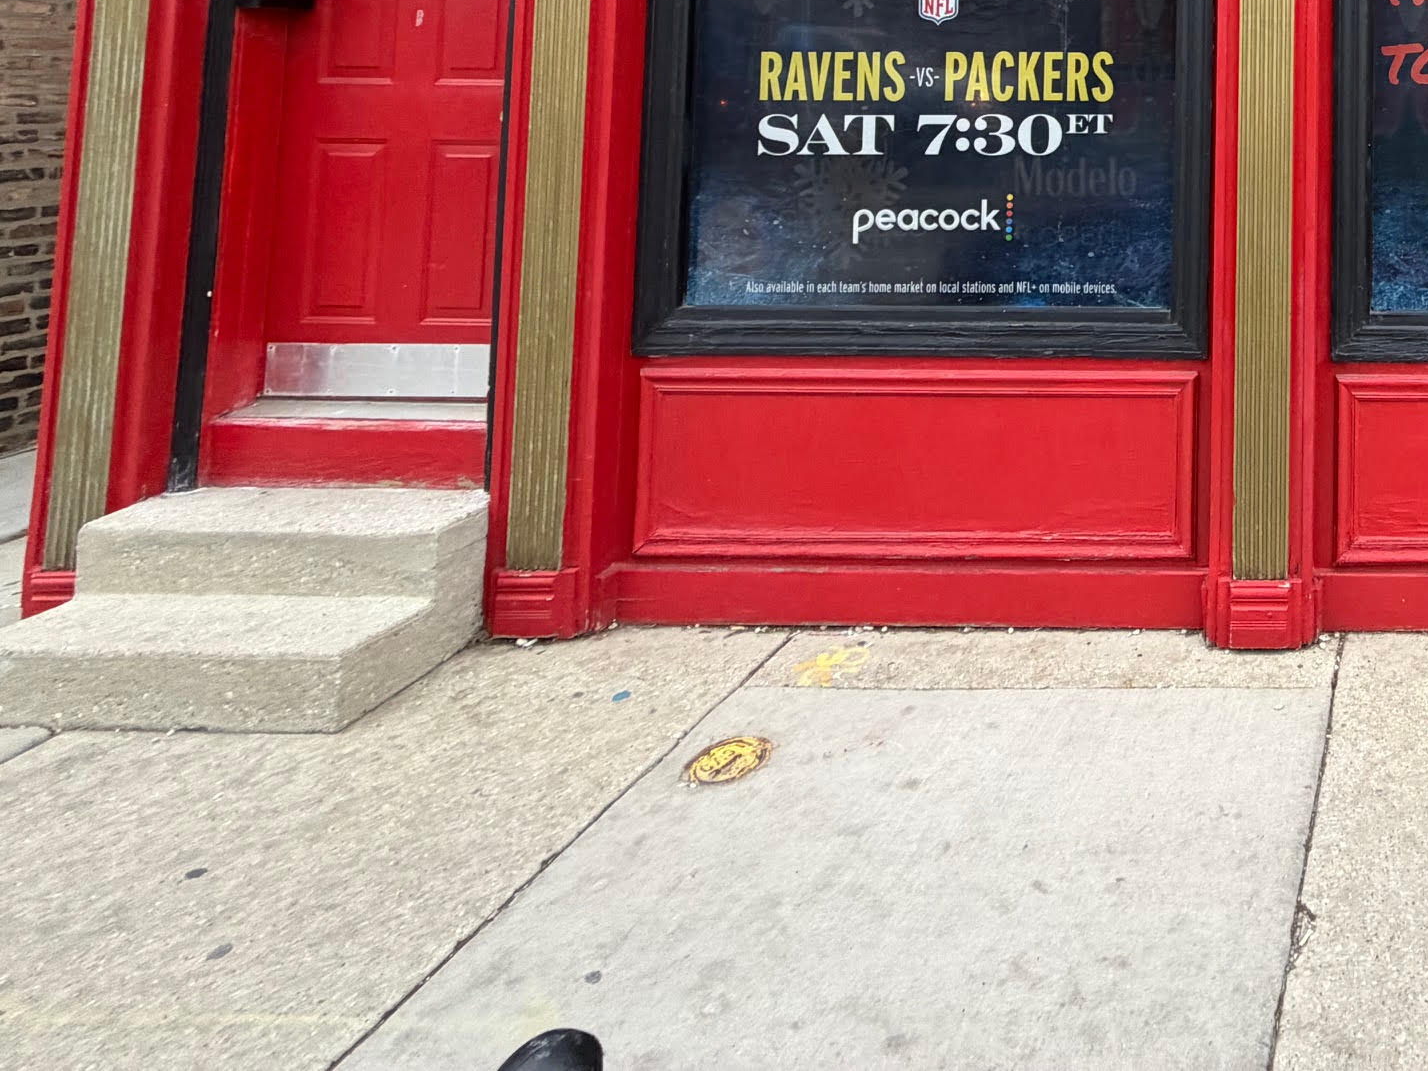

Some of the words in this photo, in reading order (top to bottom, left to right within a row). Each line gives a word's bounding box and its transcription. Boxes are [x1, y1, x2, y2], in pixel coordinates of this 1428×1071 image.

[758, 50, 906, 103] RAVENS
[944, 51, 1115, 103] PACKERS
[756, 113, 896, 157] SAT
[1012, 155, 1138, 198] Modelo
[852, 198, 1001, 245] peacock
[746, 280, 764, 294] Also
[766, 280, 804, 294] available
[806, 280, 815, 294] in
[817, 280, 837, 294] each
[838, 280, 867, 294] team's
[868, 280, 892, 294] home
[894, 280, 924, 294] market
[925, 280, 937, 294] on
[939, 280, 959, 294] local
[961, 280, 996, 294] stations
[998, 280, 1014, 294] and
[1016, 280, 1037, 294] NFL+
[1039, 280, 1050, 294] on
[1052, 280, 1081, 294] mobile
[1082, 280, 1118, 294] devices.
